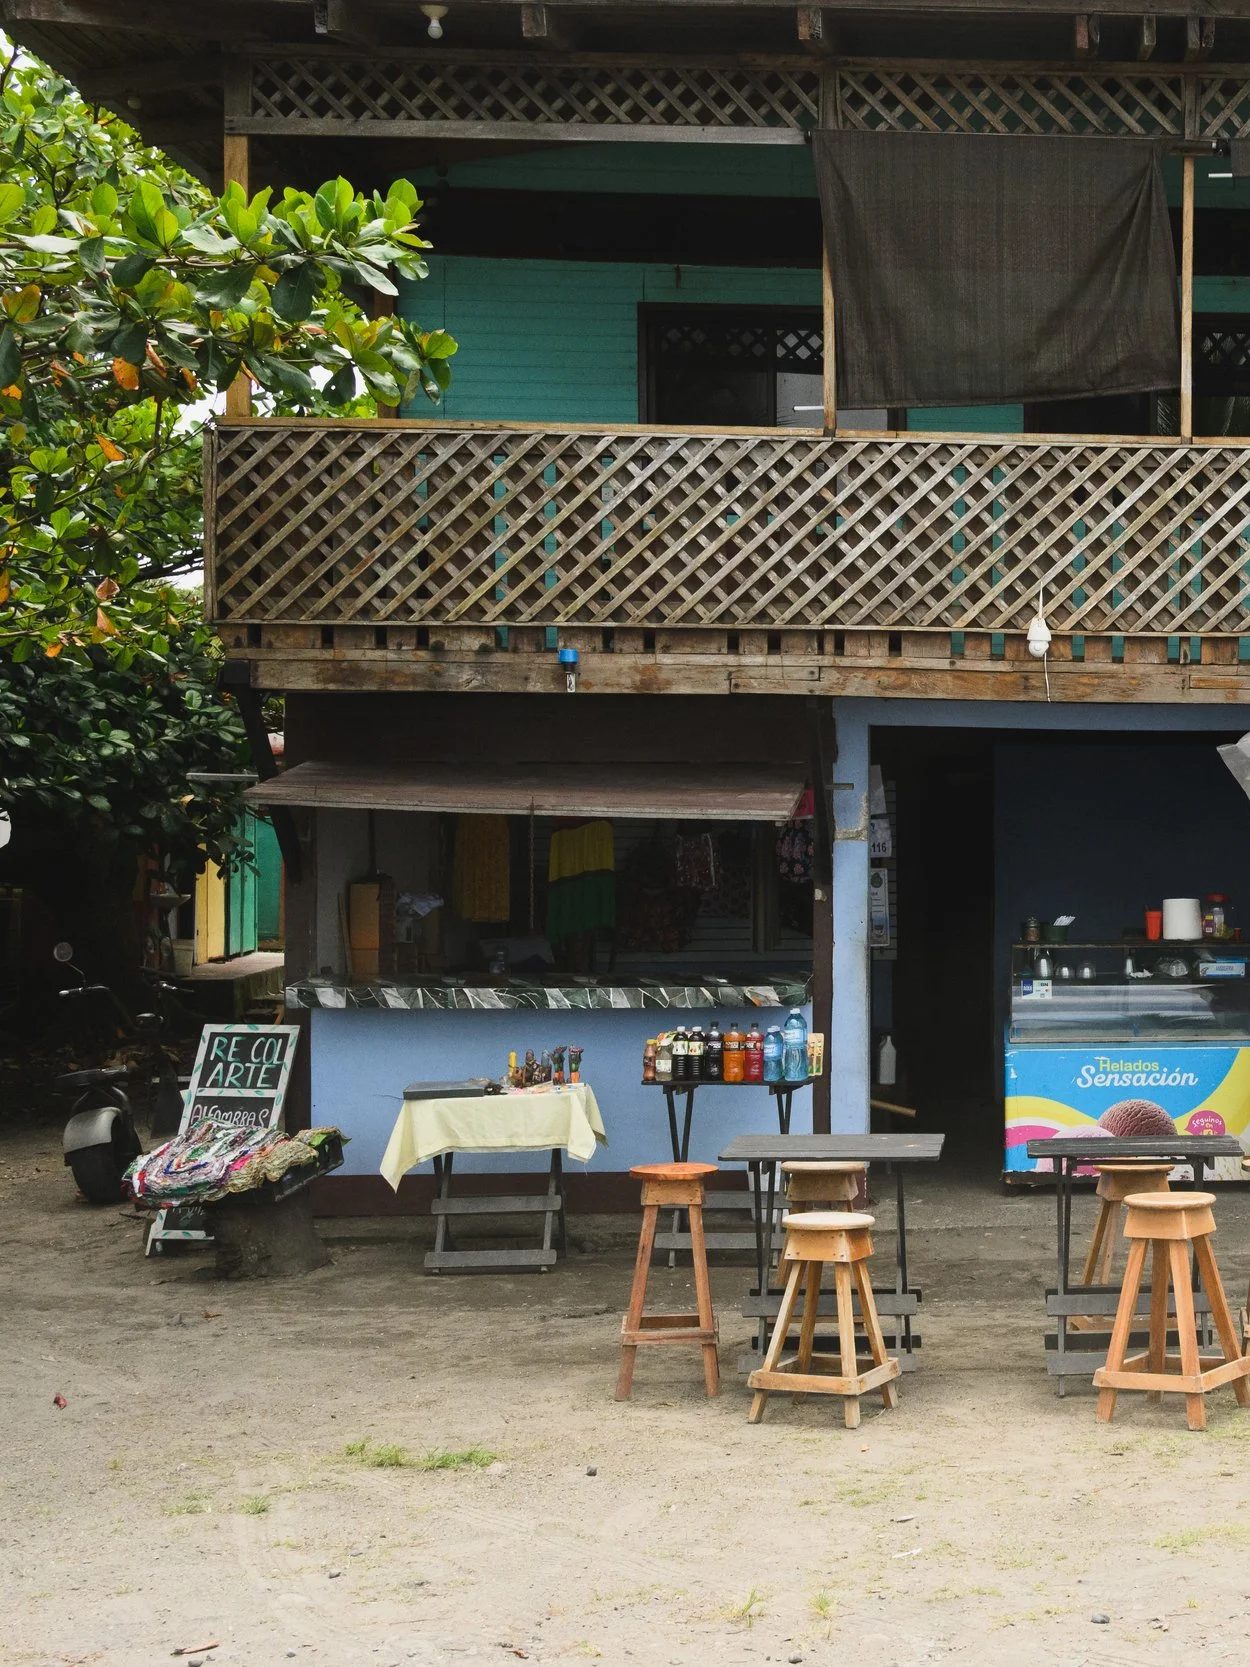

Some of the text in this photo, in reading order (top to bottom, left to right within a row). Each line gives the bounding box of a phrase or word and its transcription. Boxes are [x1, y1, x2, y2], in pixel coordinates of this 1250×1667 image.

[209, 1036, 284, 1065] RE COL
[205, 1062, 277, 1088] ARTE
[1076, 1064, 1199, 1088] Sensación
[1099, 1059, 1160, 1072] Helados
